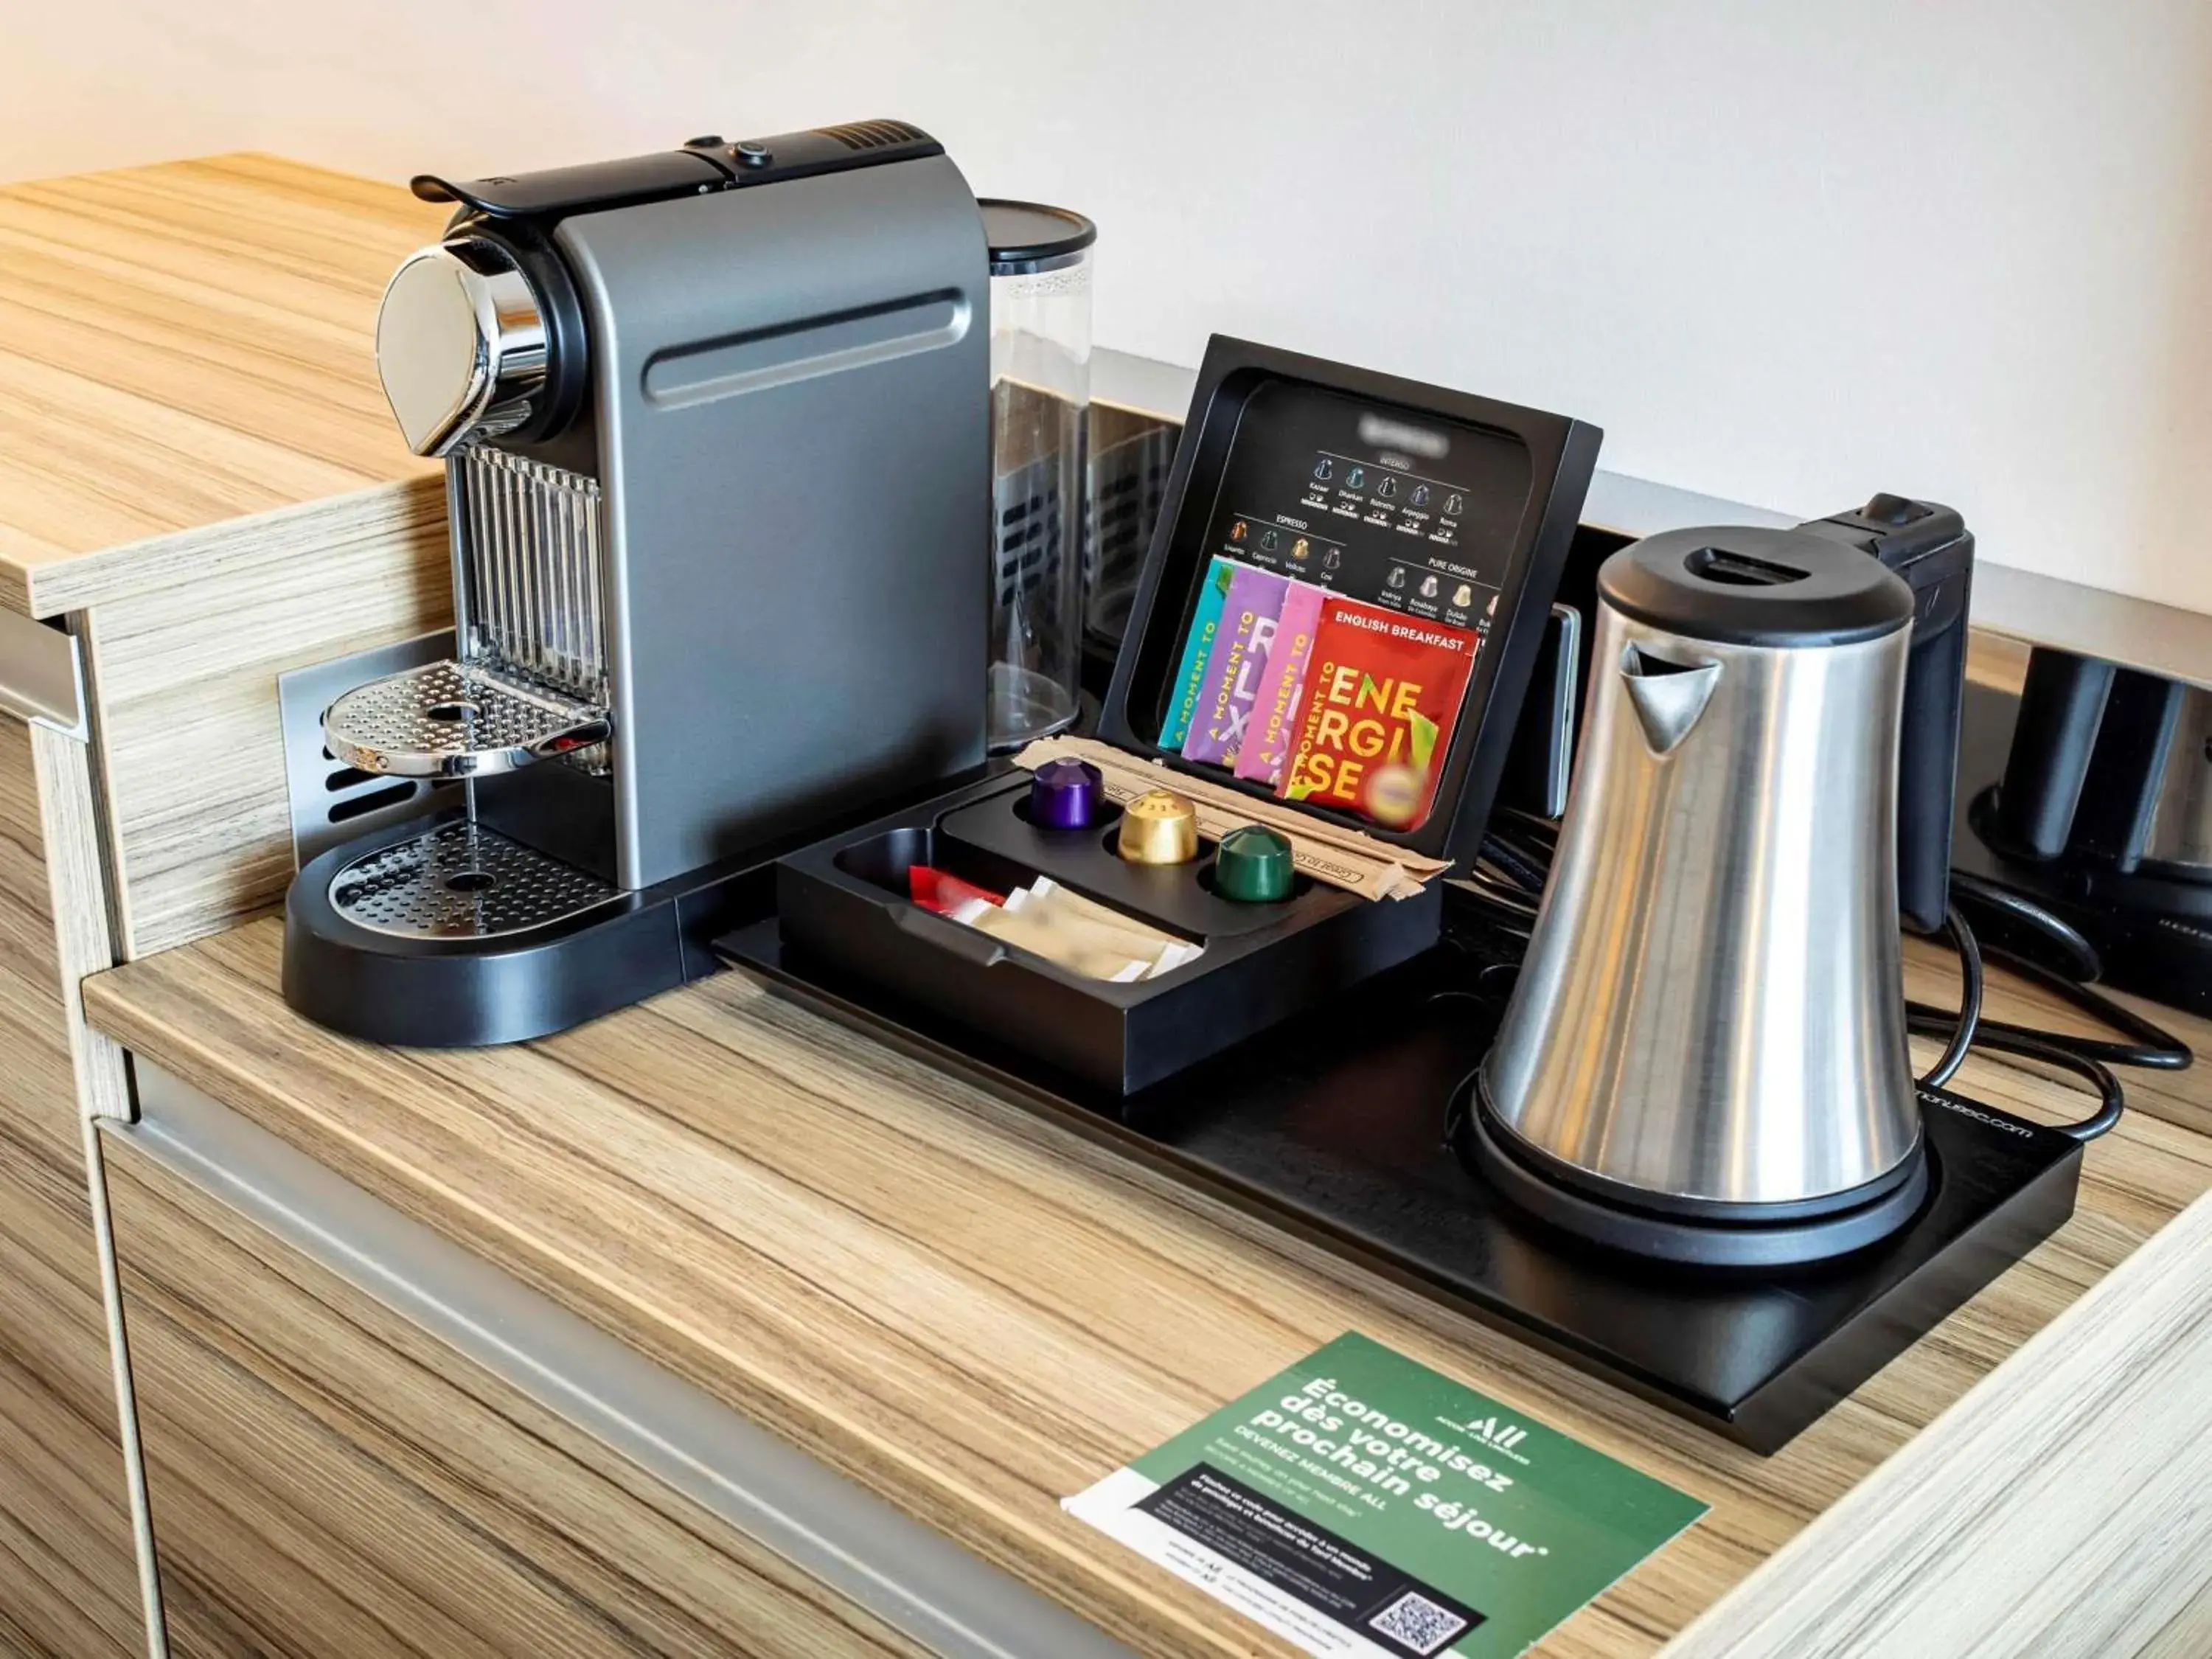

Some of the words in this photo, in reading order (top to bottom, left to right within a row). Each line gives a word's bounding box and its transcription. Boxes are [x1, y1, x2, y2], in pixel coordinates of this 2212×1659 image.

[1276, 514, 1307, 530] ESPRESSO
[1428, 557, 1447, 571] PURE
[1447, 563, 1478, 579] ORIGINE
[1237, 611, 1253, 635] TO
[1290, 633, 1308, 658] TO
[1335, 611, 1389, 633] ENGLISH
[1391, 625, 1464, 651] BREAKFAST
[1180, 649, 1207, 723] MOMENT
[1202, 622, 1216, 643] TO
[1213, 641, 1245, 720] MOMENT
[1319, 661, 1335, 686] TO
[1329, 666, 1424, 723] ENE
[1265, 663, 1298, 744] MOMENT
[1208, 727, 1220, 741] A
[1259, 751, 1272, 764] A
[1315, 709, 1404, 764] RGI
[1308, 753, 1364, 801] SE
[1250, 1409, 1411, 1496] prochain
[1280, 1393, 1344, 1431] dès
[1348, 1428, 1441, 1482] votre
[1302, 1377, 1514, 1492] Économisez
[1466, 1416, 1529, 1449] All
[1234, 1425, 1301, 1464] DEVENEZ
[1297, 1458, 1363, 1496] MEMBRE
[1360, 1492, 1387, 1510] ALL
